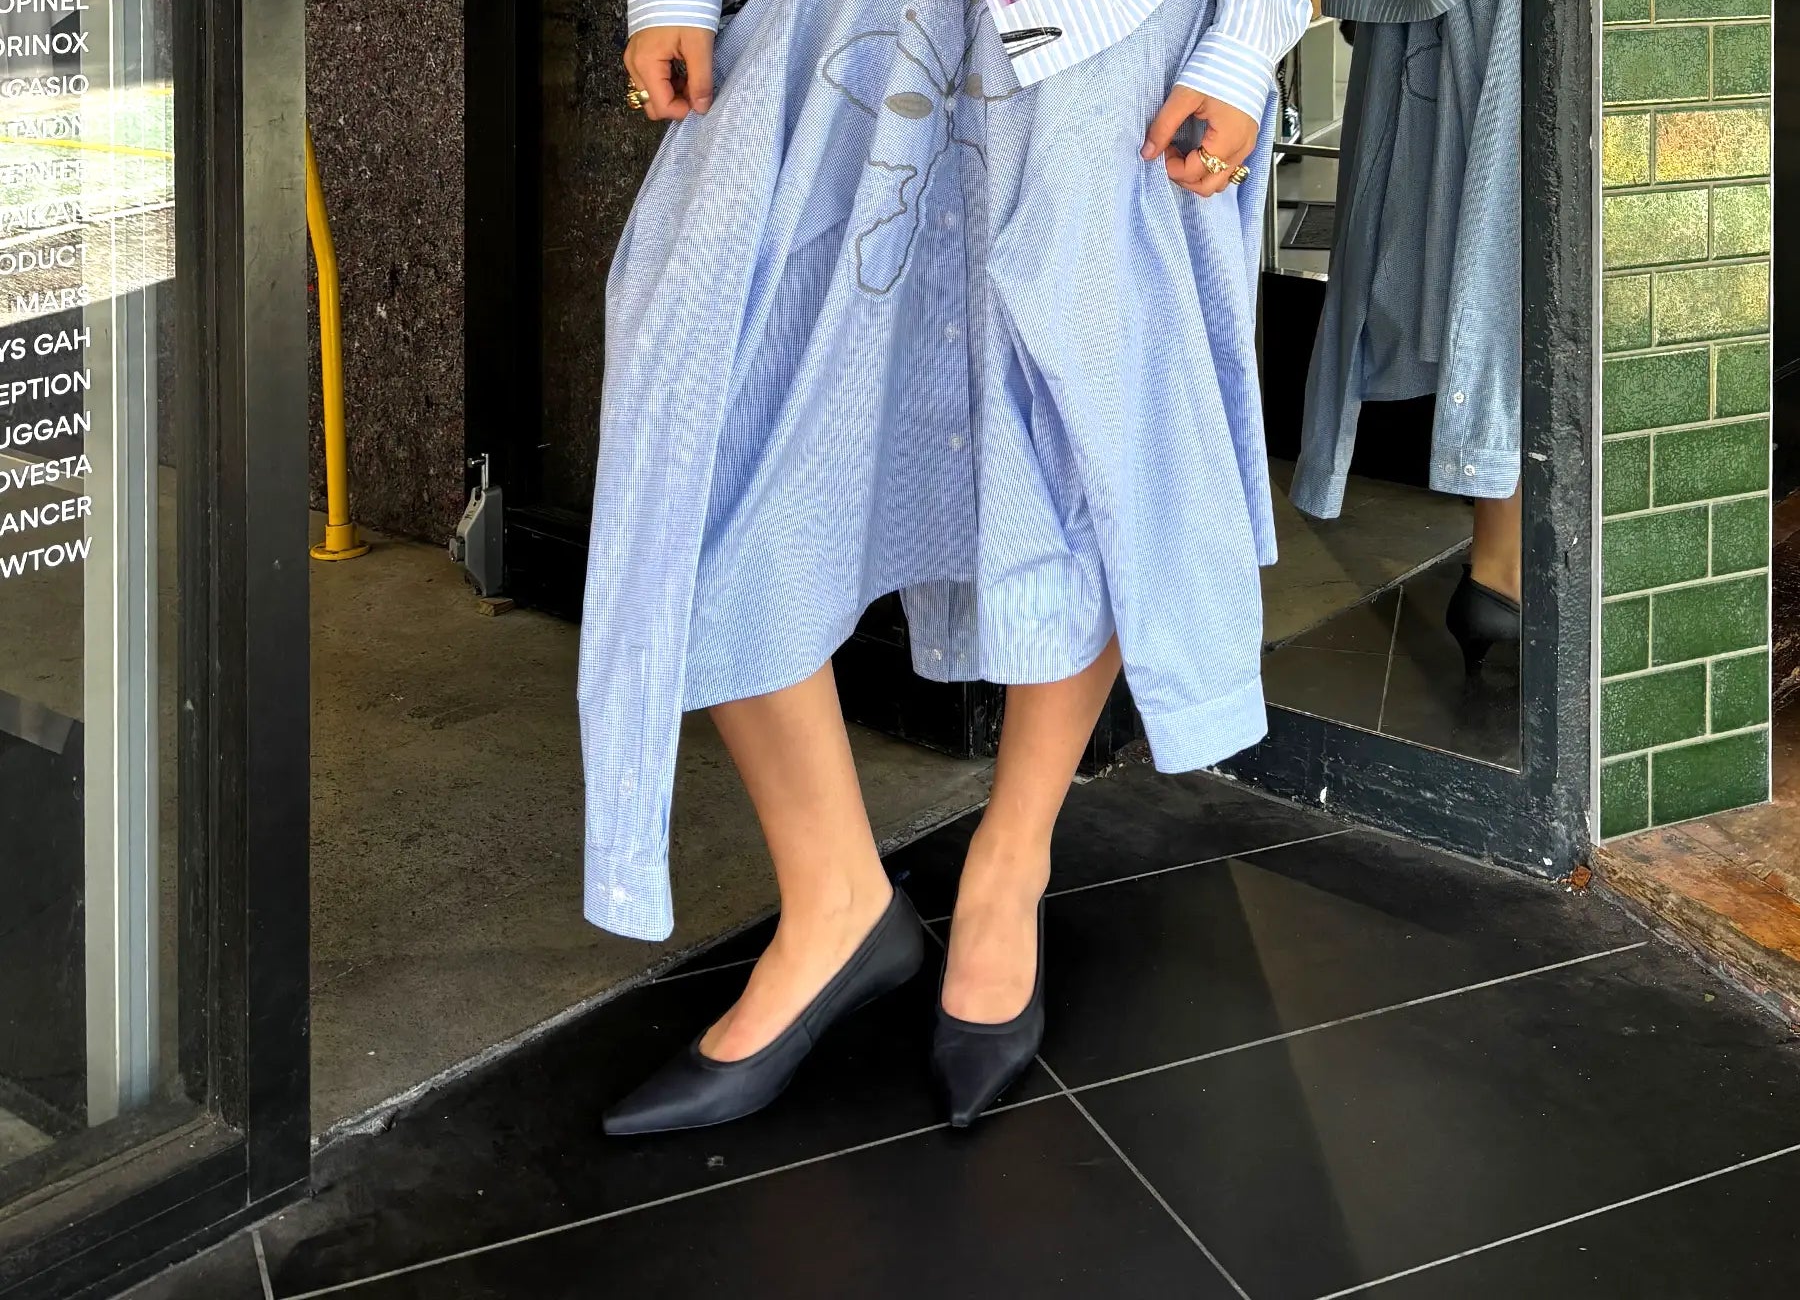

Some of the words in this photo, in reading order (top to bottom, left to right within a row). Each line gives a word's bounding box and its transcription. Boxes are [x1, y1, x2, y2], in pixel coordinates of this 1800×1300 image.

[0, 31, 89, 57] RINOX
[7, 74, 89, 98] CASIO
[16, 283, 91, 314] MARS
[34, 326, 91, 356] GAH
[0, 495, 92, 536] ANCER
[0, 536, 93, 579] WTOW
